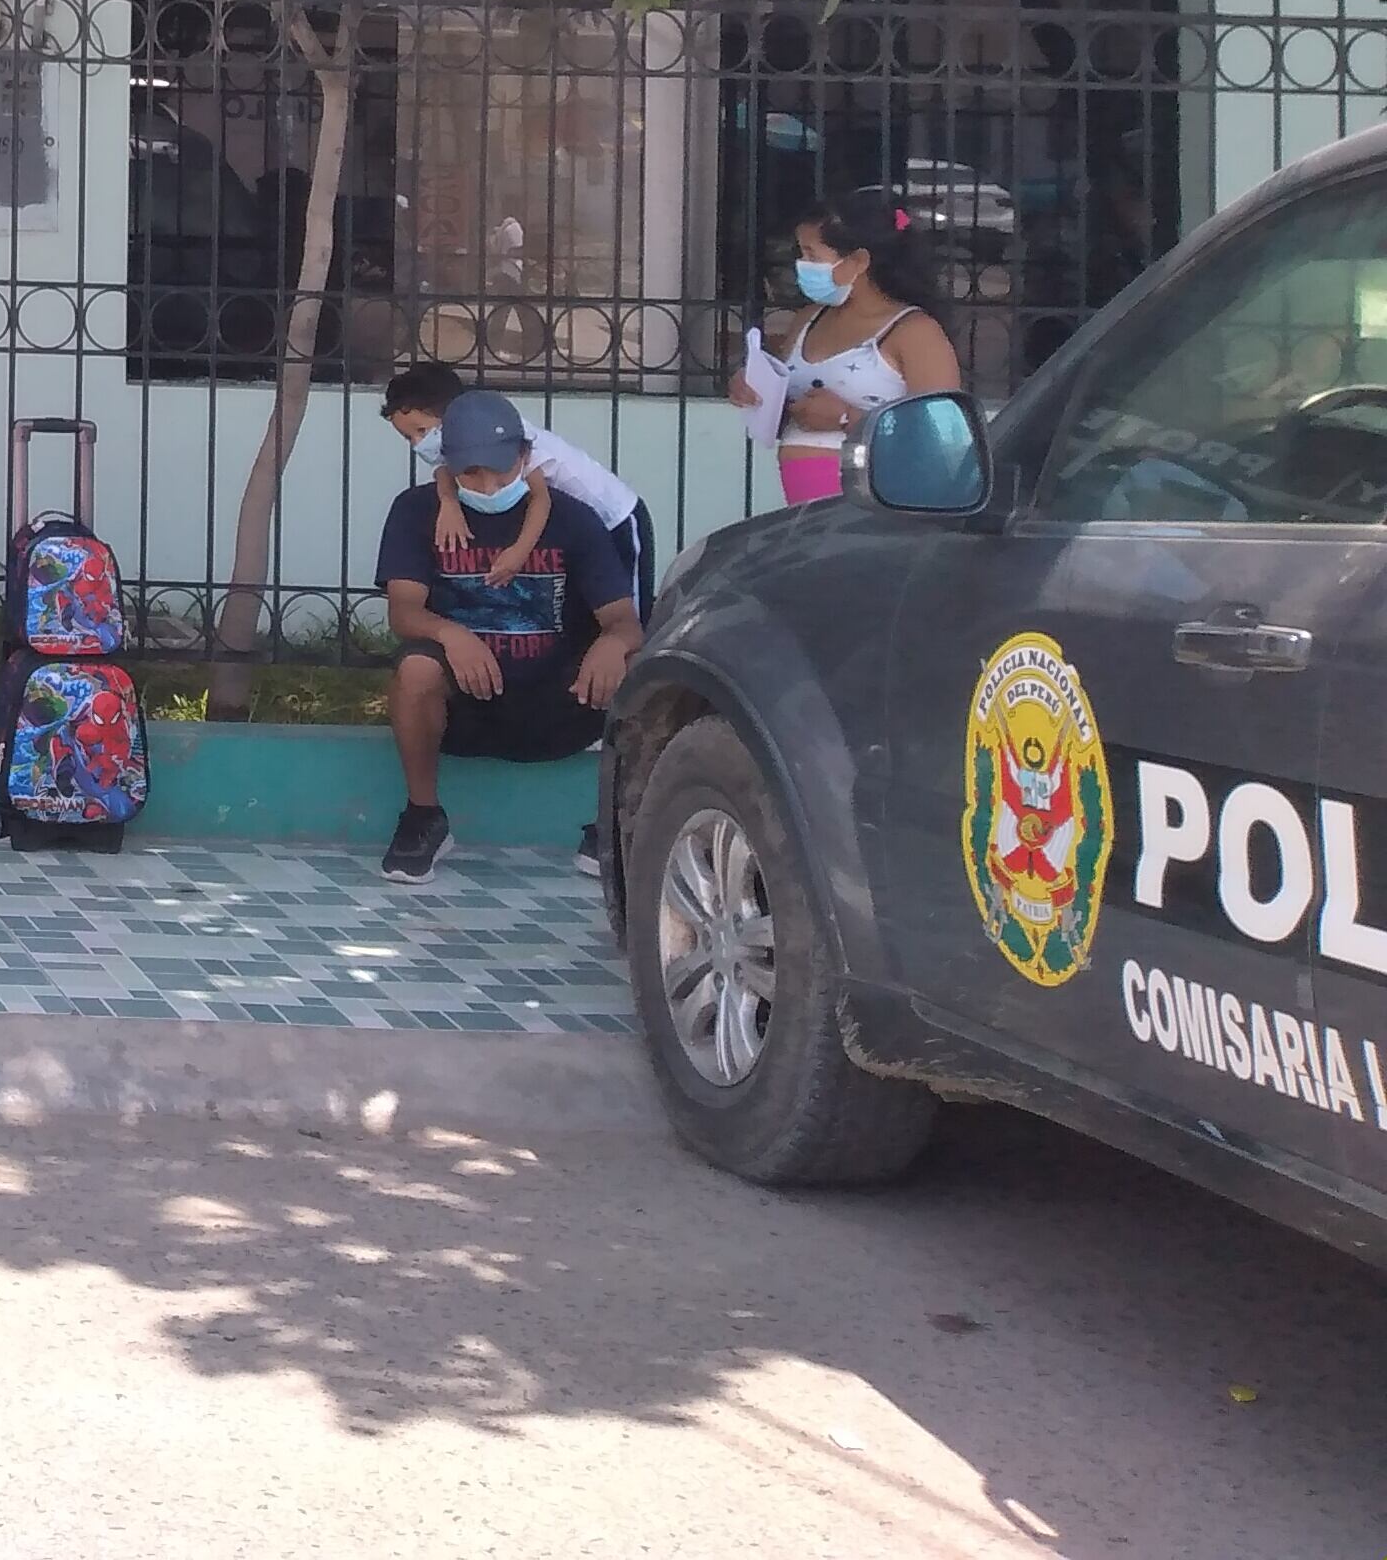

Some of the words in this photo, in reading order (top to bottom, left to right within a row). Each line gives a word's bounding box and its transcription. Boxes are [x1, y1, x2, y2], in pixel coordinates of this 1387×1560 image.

[978, 650, 1026, 715] POLICIA
[1028, 649, 1089, 737] NACIONAL
[1007, 682, 1028, 704] DEL
[1122, 958, 1366, 1123] COMISARIA
